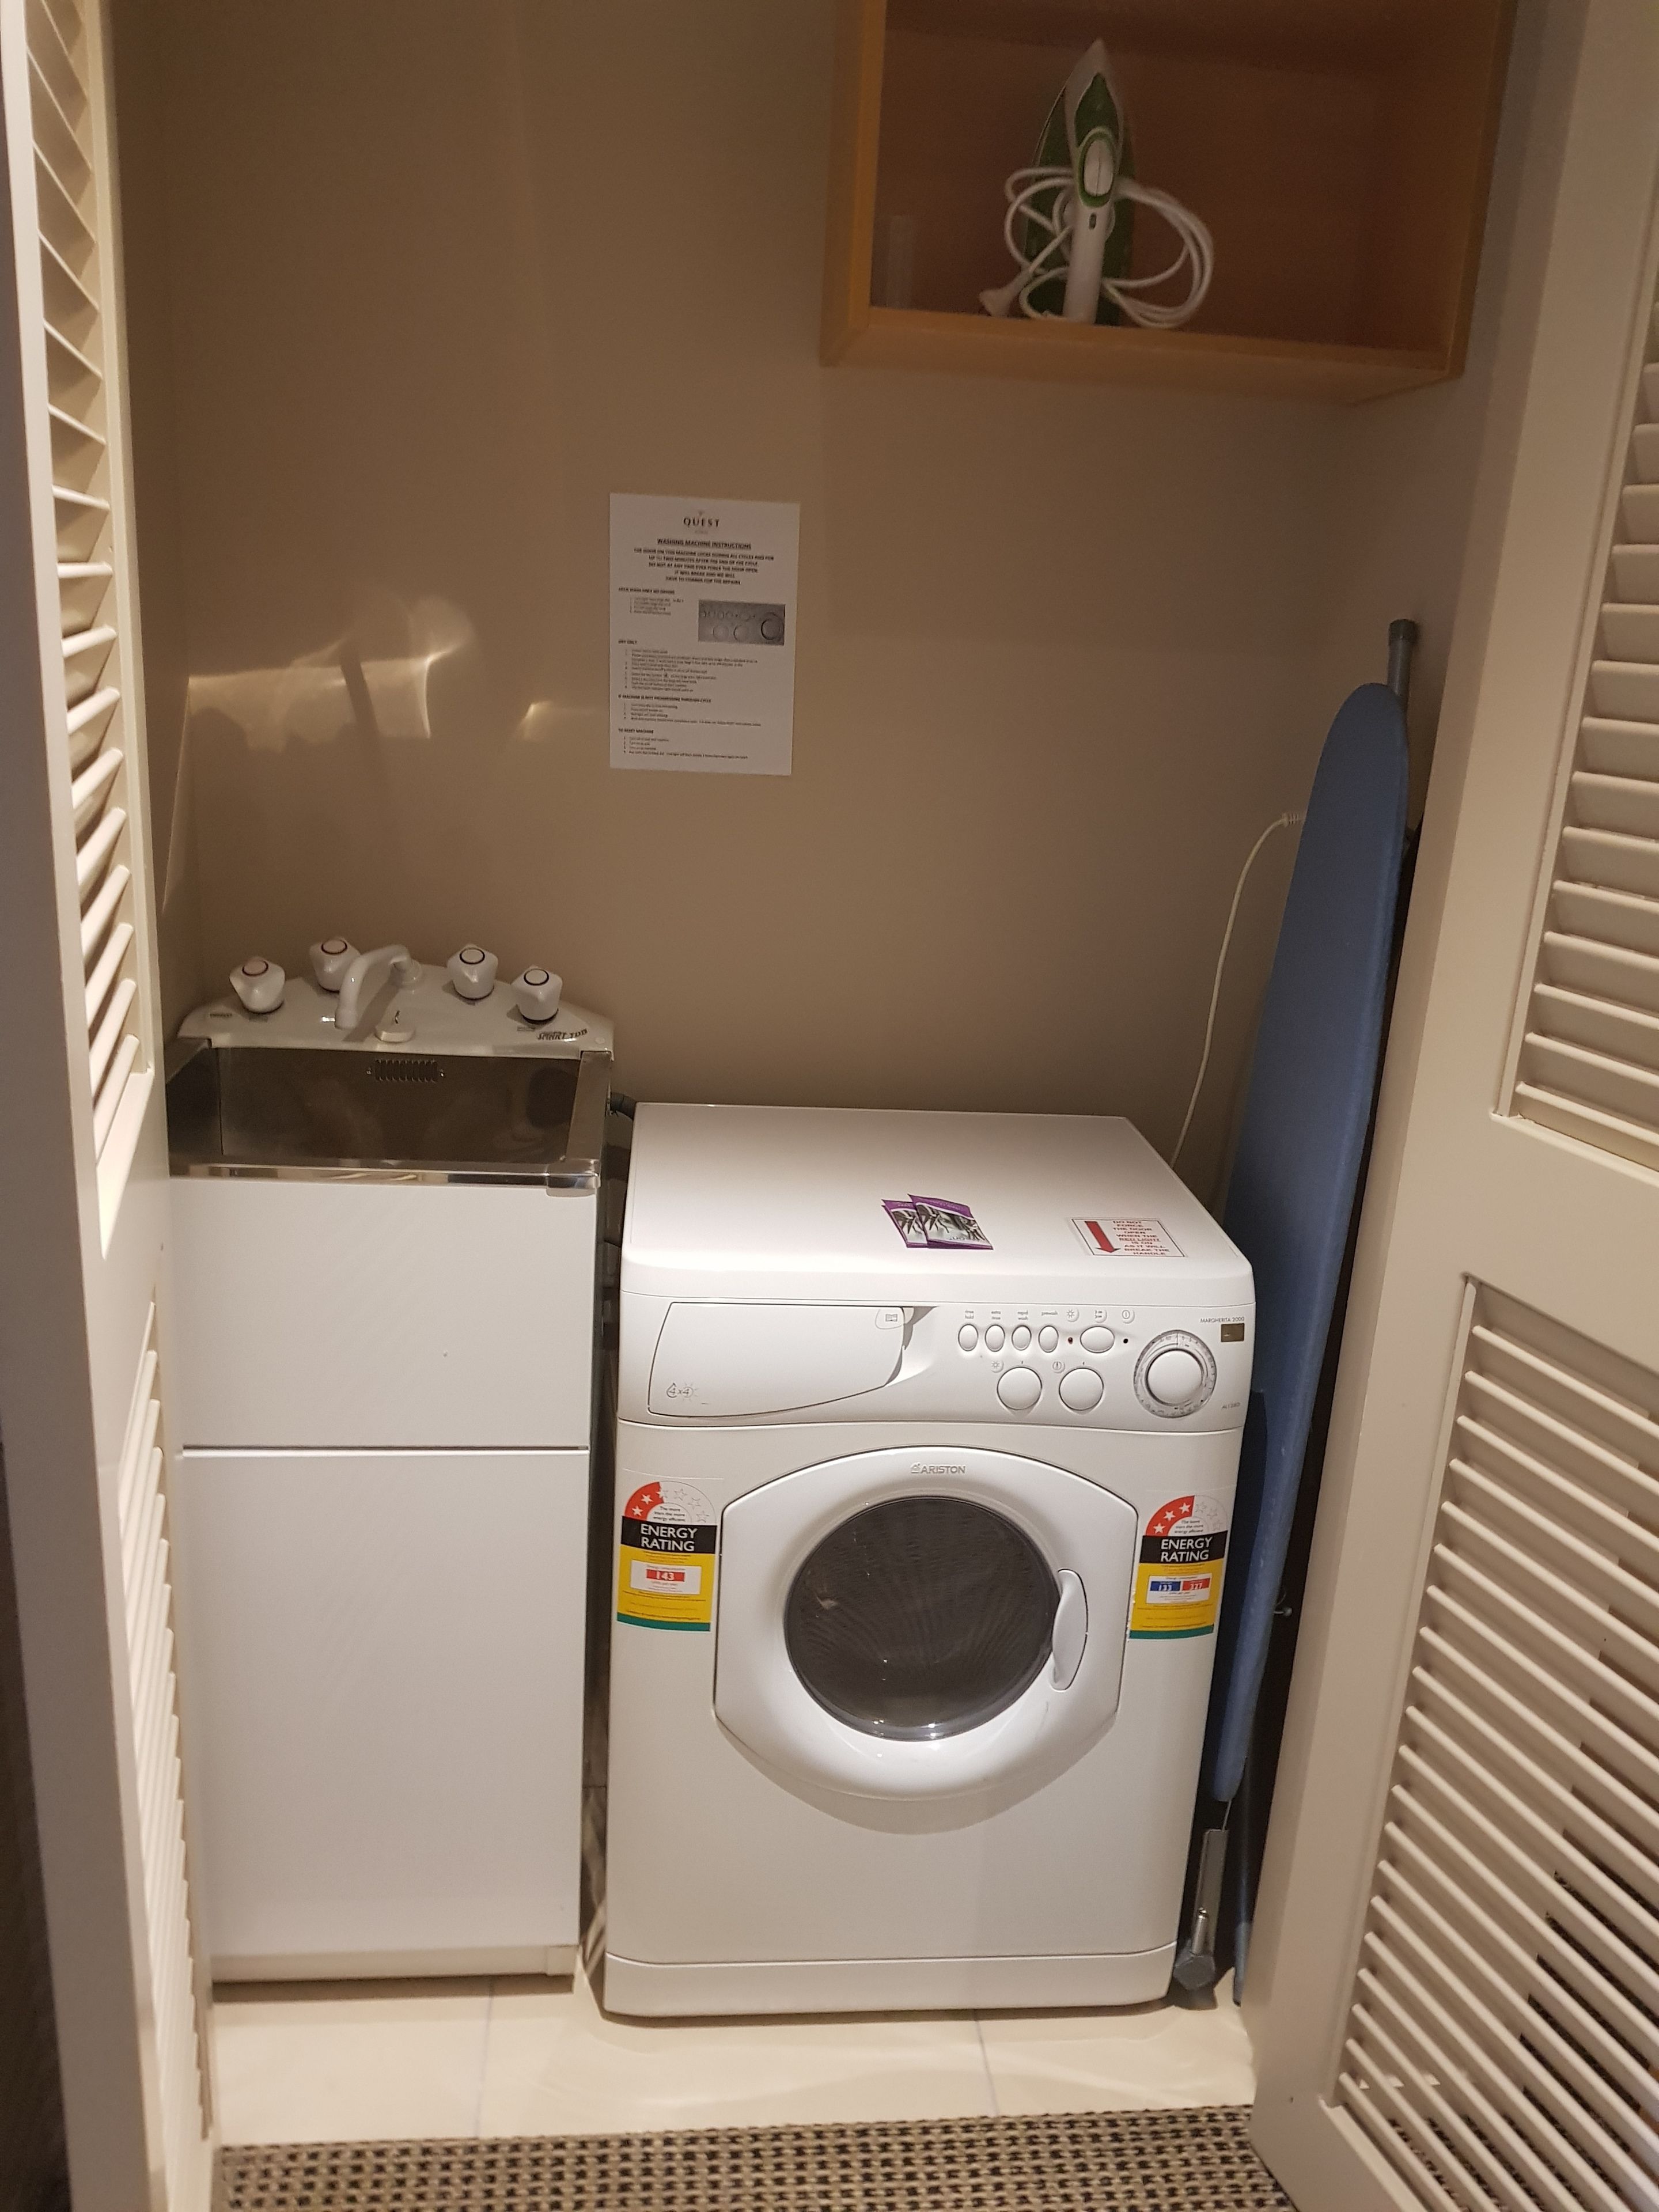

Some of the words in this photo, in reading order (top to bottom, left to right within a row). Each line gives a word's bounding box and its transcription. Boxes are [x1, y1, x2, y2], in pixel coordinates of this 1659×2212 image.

[683, 517, 719, 528] QUEST
[712, 541, 751, 550] INSTRUCTIONS
[921, 1465, 966, 1474] ARISTON
[640, 1523, 698, 1539] ENERGY
[641, 1536, 695, 1551] RATING
[1161, 1536, 1213, 1550] ENERGY
[1160, 1550, 1209, 1562] RATING
[656, 1571, 674, 1580] 143
